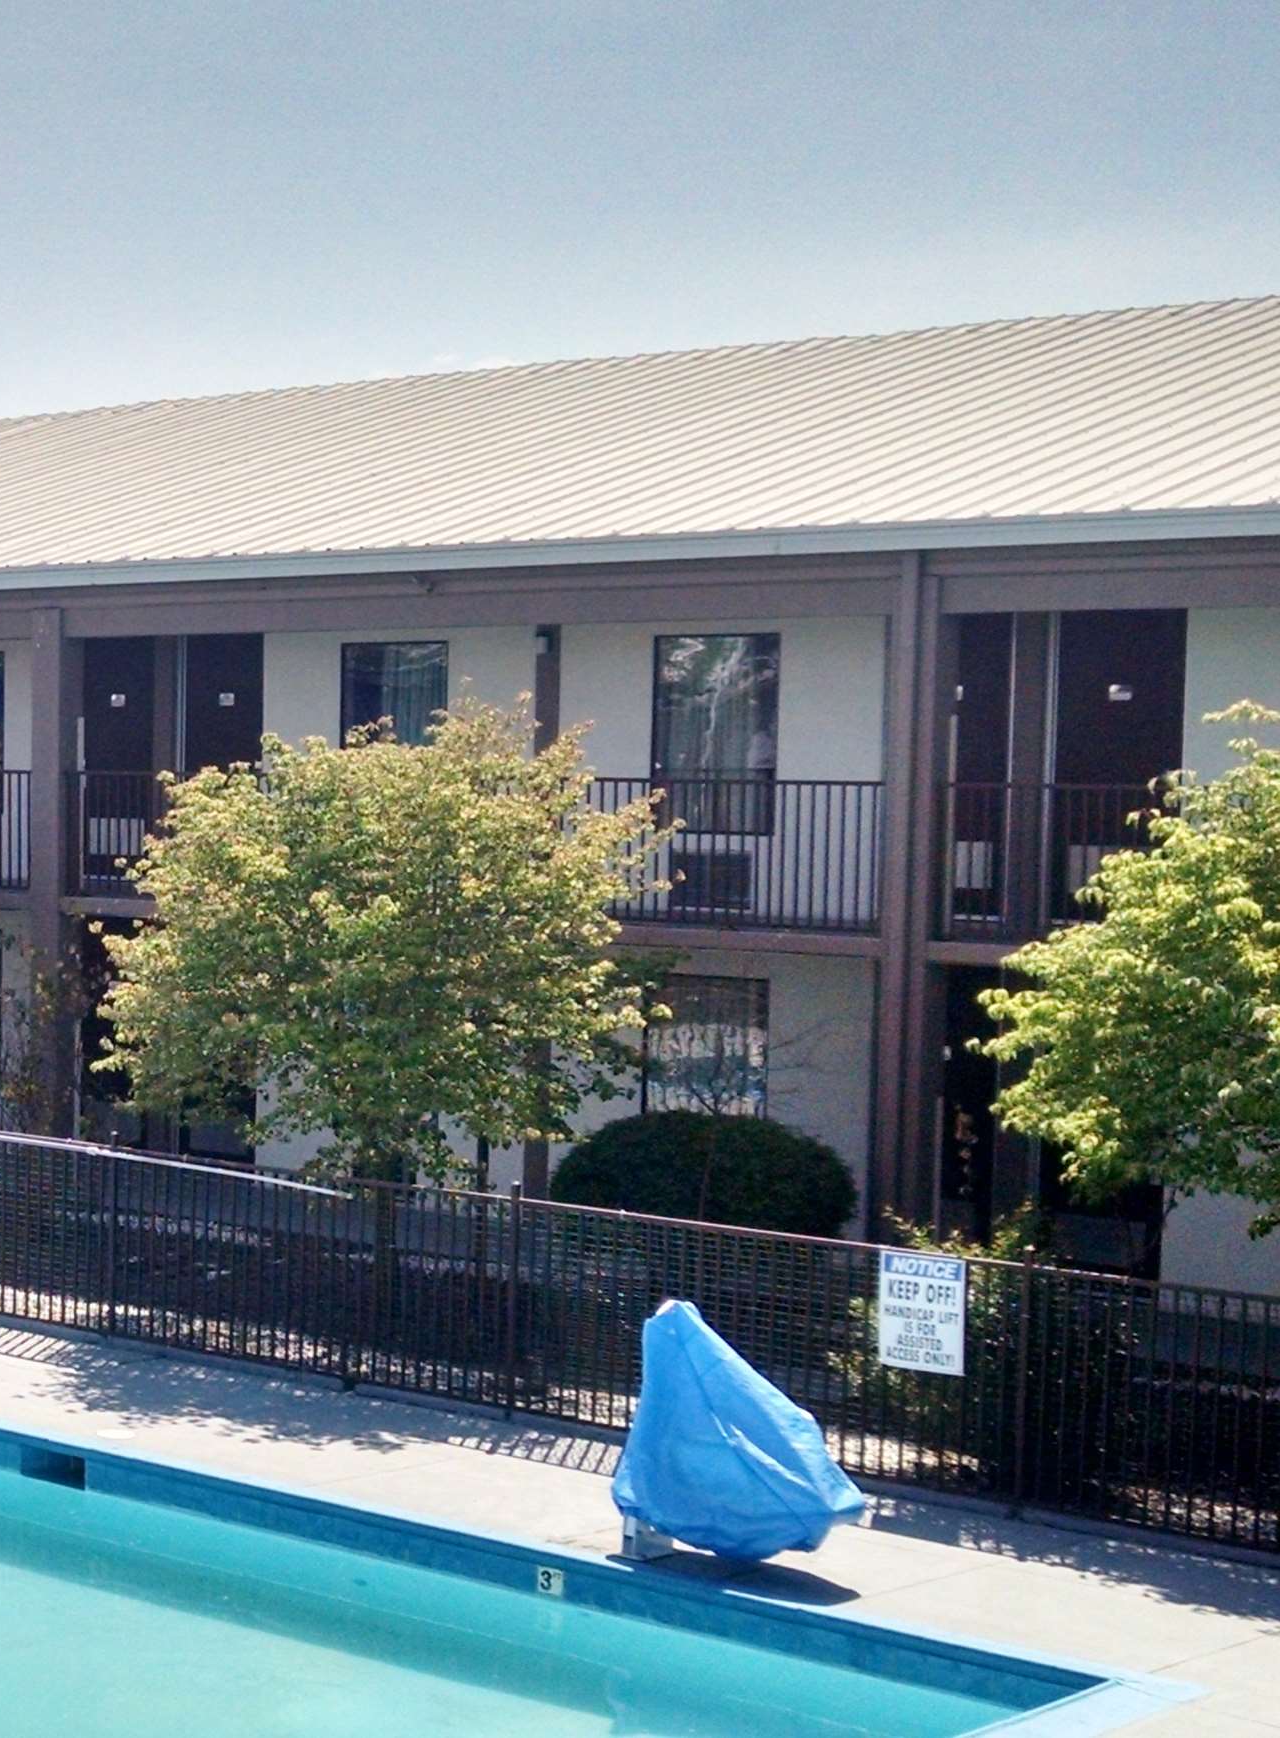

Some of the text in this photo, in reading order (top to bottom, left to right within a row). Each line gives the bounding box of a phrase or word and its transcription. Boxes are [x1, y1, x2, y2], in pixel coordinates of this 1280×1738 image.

[890, 1257, 959, 1279] NOTICE
[888, 1278, 957, 1306] KEEP OFF!
[884, 1304, 959, 1326] HANDICAP LIFT
[904, 1321, 936, 1336] IS FOR
[897, 1334, 943, 1351] ASSISTED
[886, 1345, 920, 1362] ACCESS
[540, 1570, 553, 1591] 3
